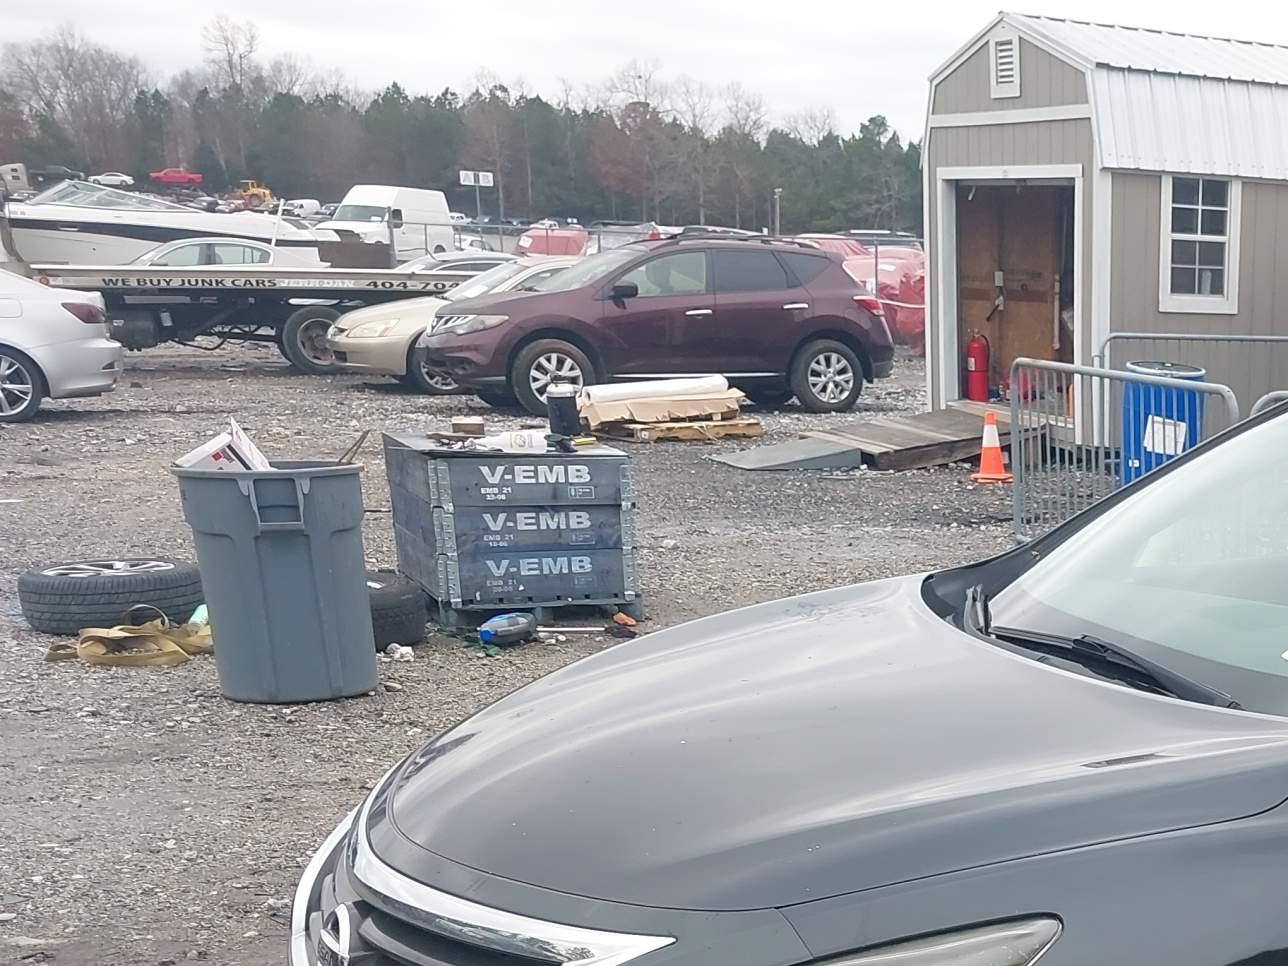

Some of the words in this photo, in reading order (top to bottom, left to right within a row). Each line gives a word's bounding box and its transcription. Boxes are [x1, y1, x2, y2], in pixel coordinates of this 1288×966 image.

[102, 278, 131, 287] WE
[137, 278, 173, 287] BUY
[178, 278, 226, 287] JUNK
[231, 278, 277, 288] CARS
[479, 465, 592, 484] V-EMB
[482, 512, 592, 531] V-EMB
[485, 556, 592, 577] V-EMB
